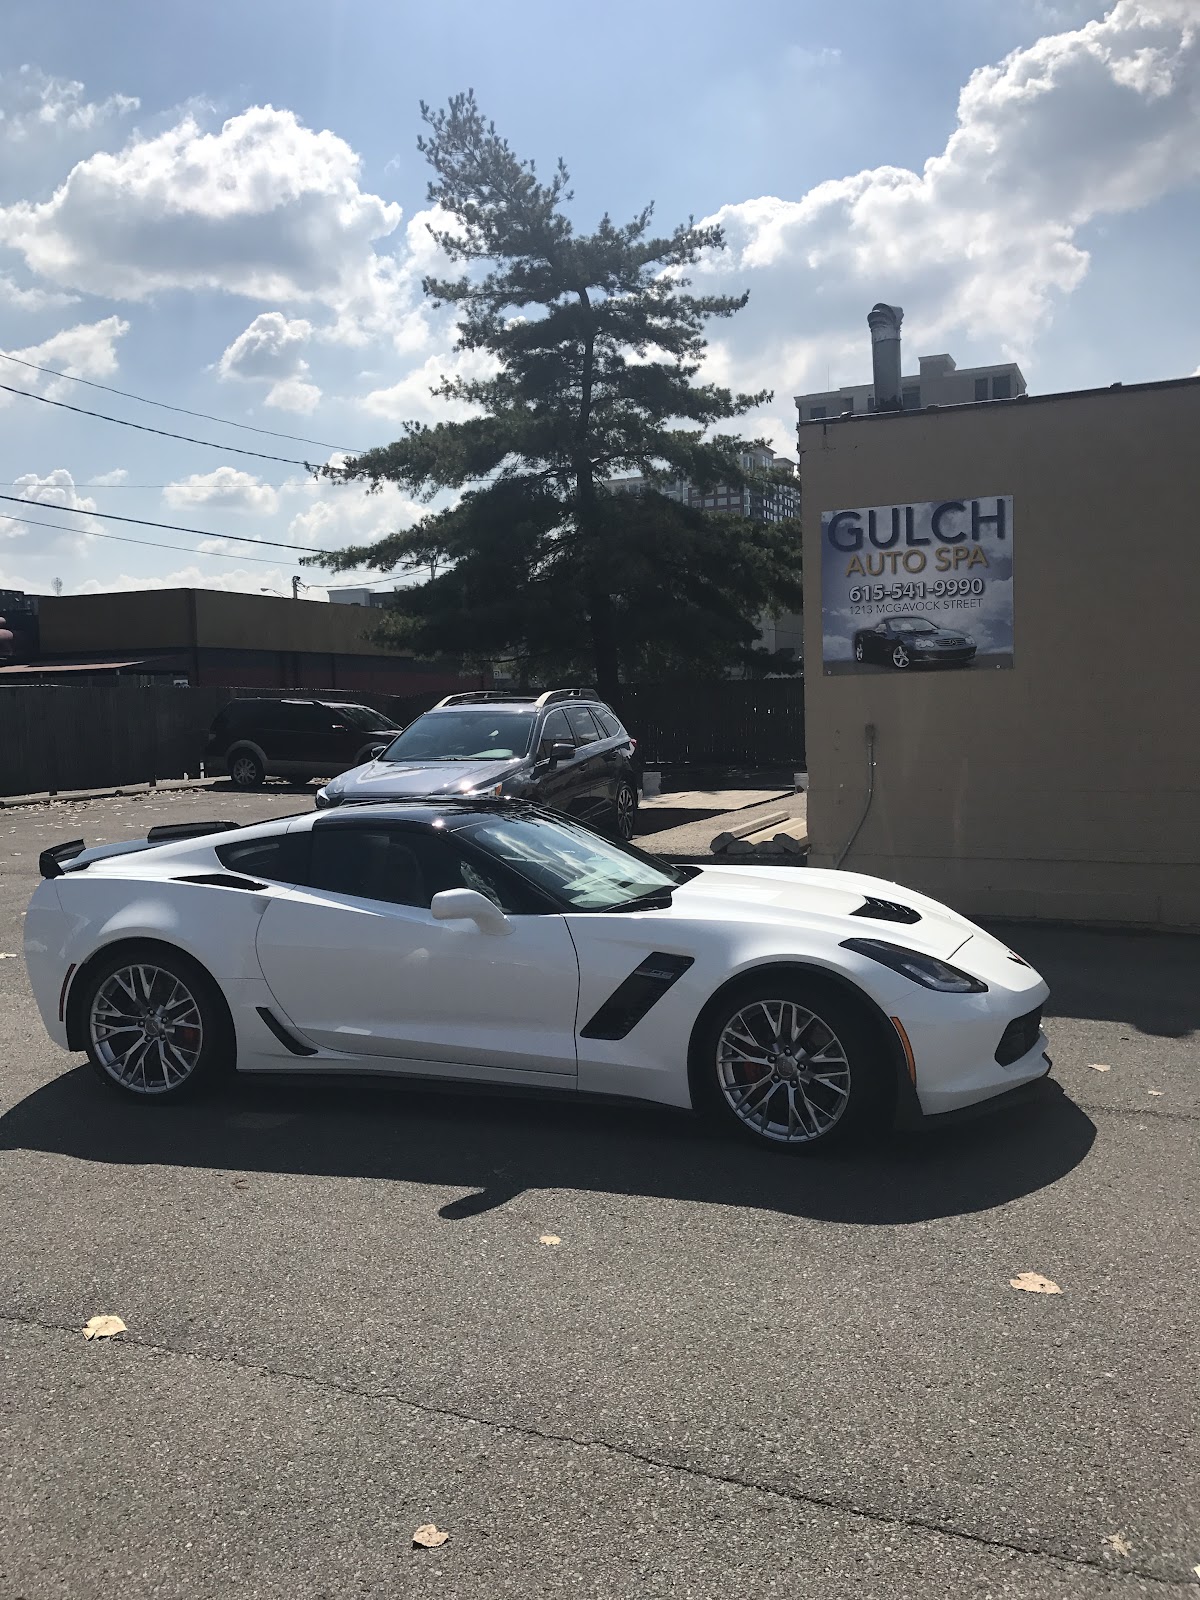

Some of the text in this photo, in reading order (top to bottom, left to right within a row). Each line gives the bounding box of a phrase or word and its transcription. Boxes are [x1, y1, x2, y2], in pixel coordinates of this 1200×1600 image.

[828, 499, 1006, 551] GULCH
[845, 545, 989, 577] AUTO SPA
[849, 578, 984, 602] 615-541-9990
[850, 598, 983, 615] 1213 MCGAVOCK STREET
